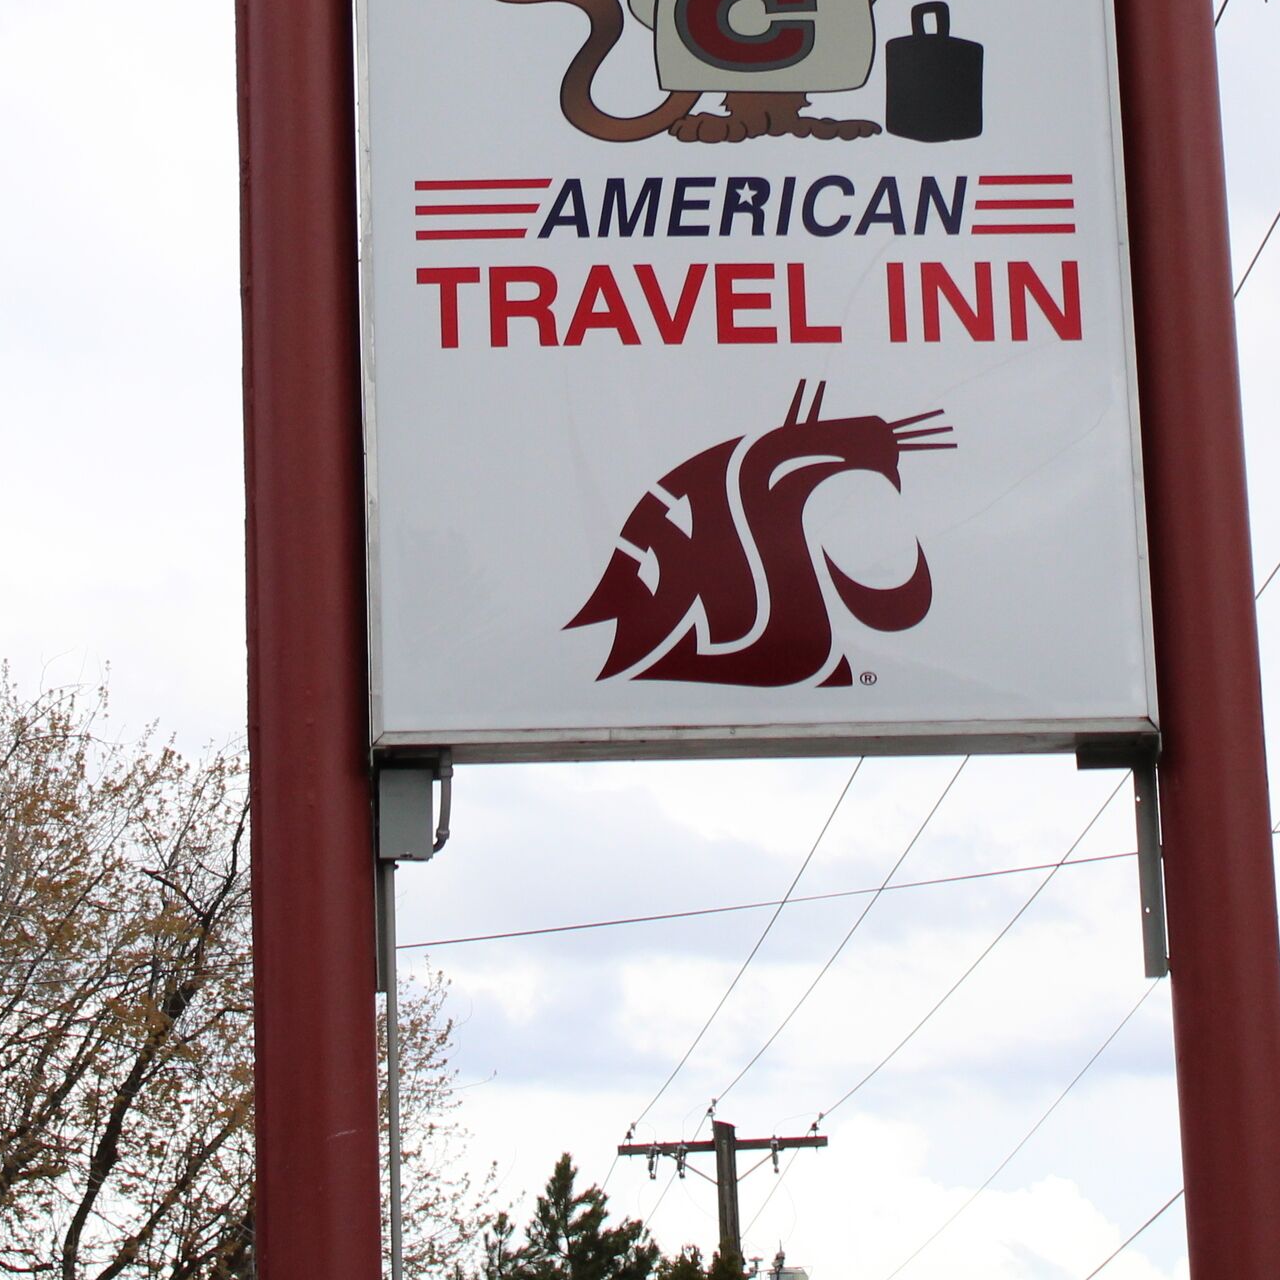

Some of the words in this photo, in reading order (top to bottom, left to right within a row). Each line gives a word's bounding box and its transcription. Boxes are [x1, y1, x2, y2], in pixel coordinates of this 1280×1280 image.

[538, 175, 968, 238] AMERICAN
[416, 262, 843, 349] TRAVEL
[886, 260, 1083, 343] INN
